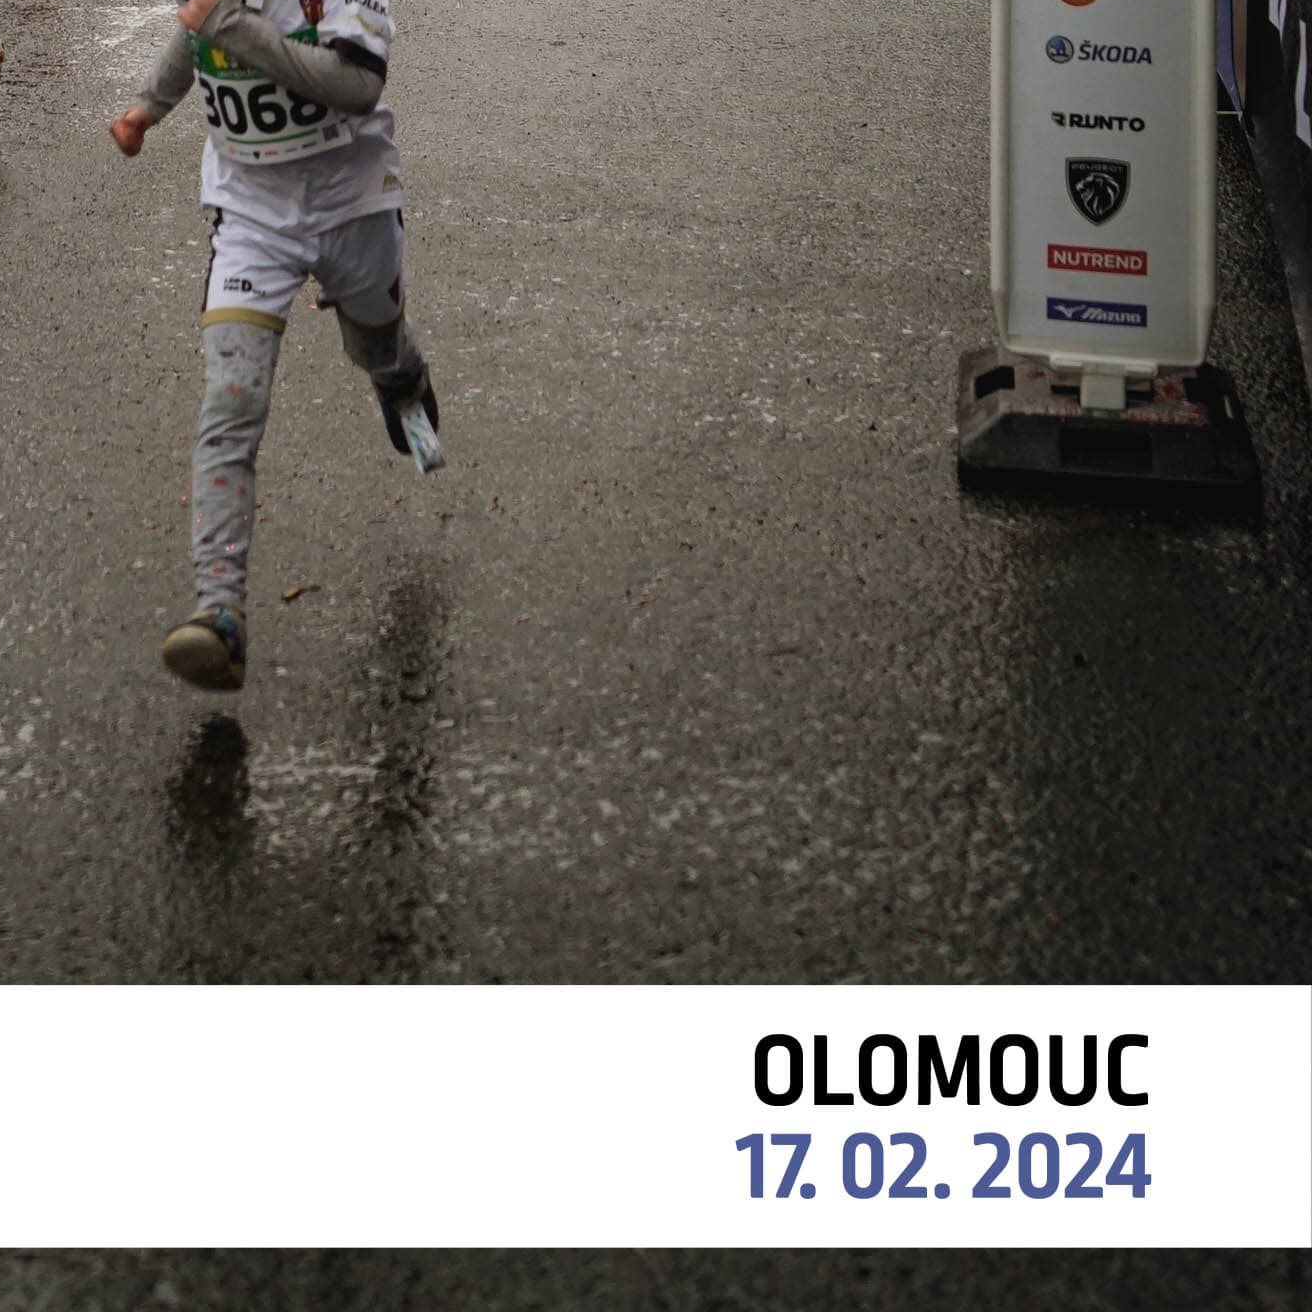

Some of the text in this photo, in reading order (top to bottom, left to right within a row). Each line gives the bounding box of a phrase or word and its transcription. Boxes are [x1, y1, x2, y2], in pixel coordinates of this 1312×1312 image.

[1078, 40, 1153, 65] ŠKODA
[1069, 113, 1145, 132] RUNTO
[1052, 249, 1143, 271] NUTREND
